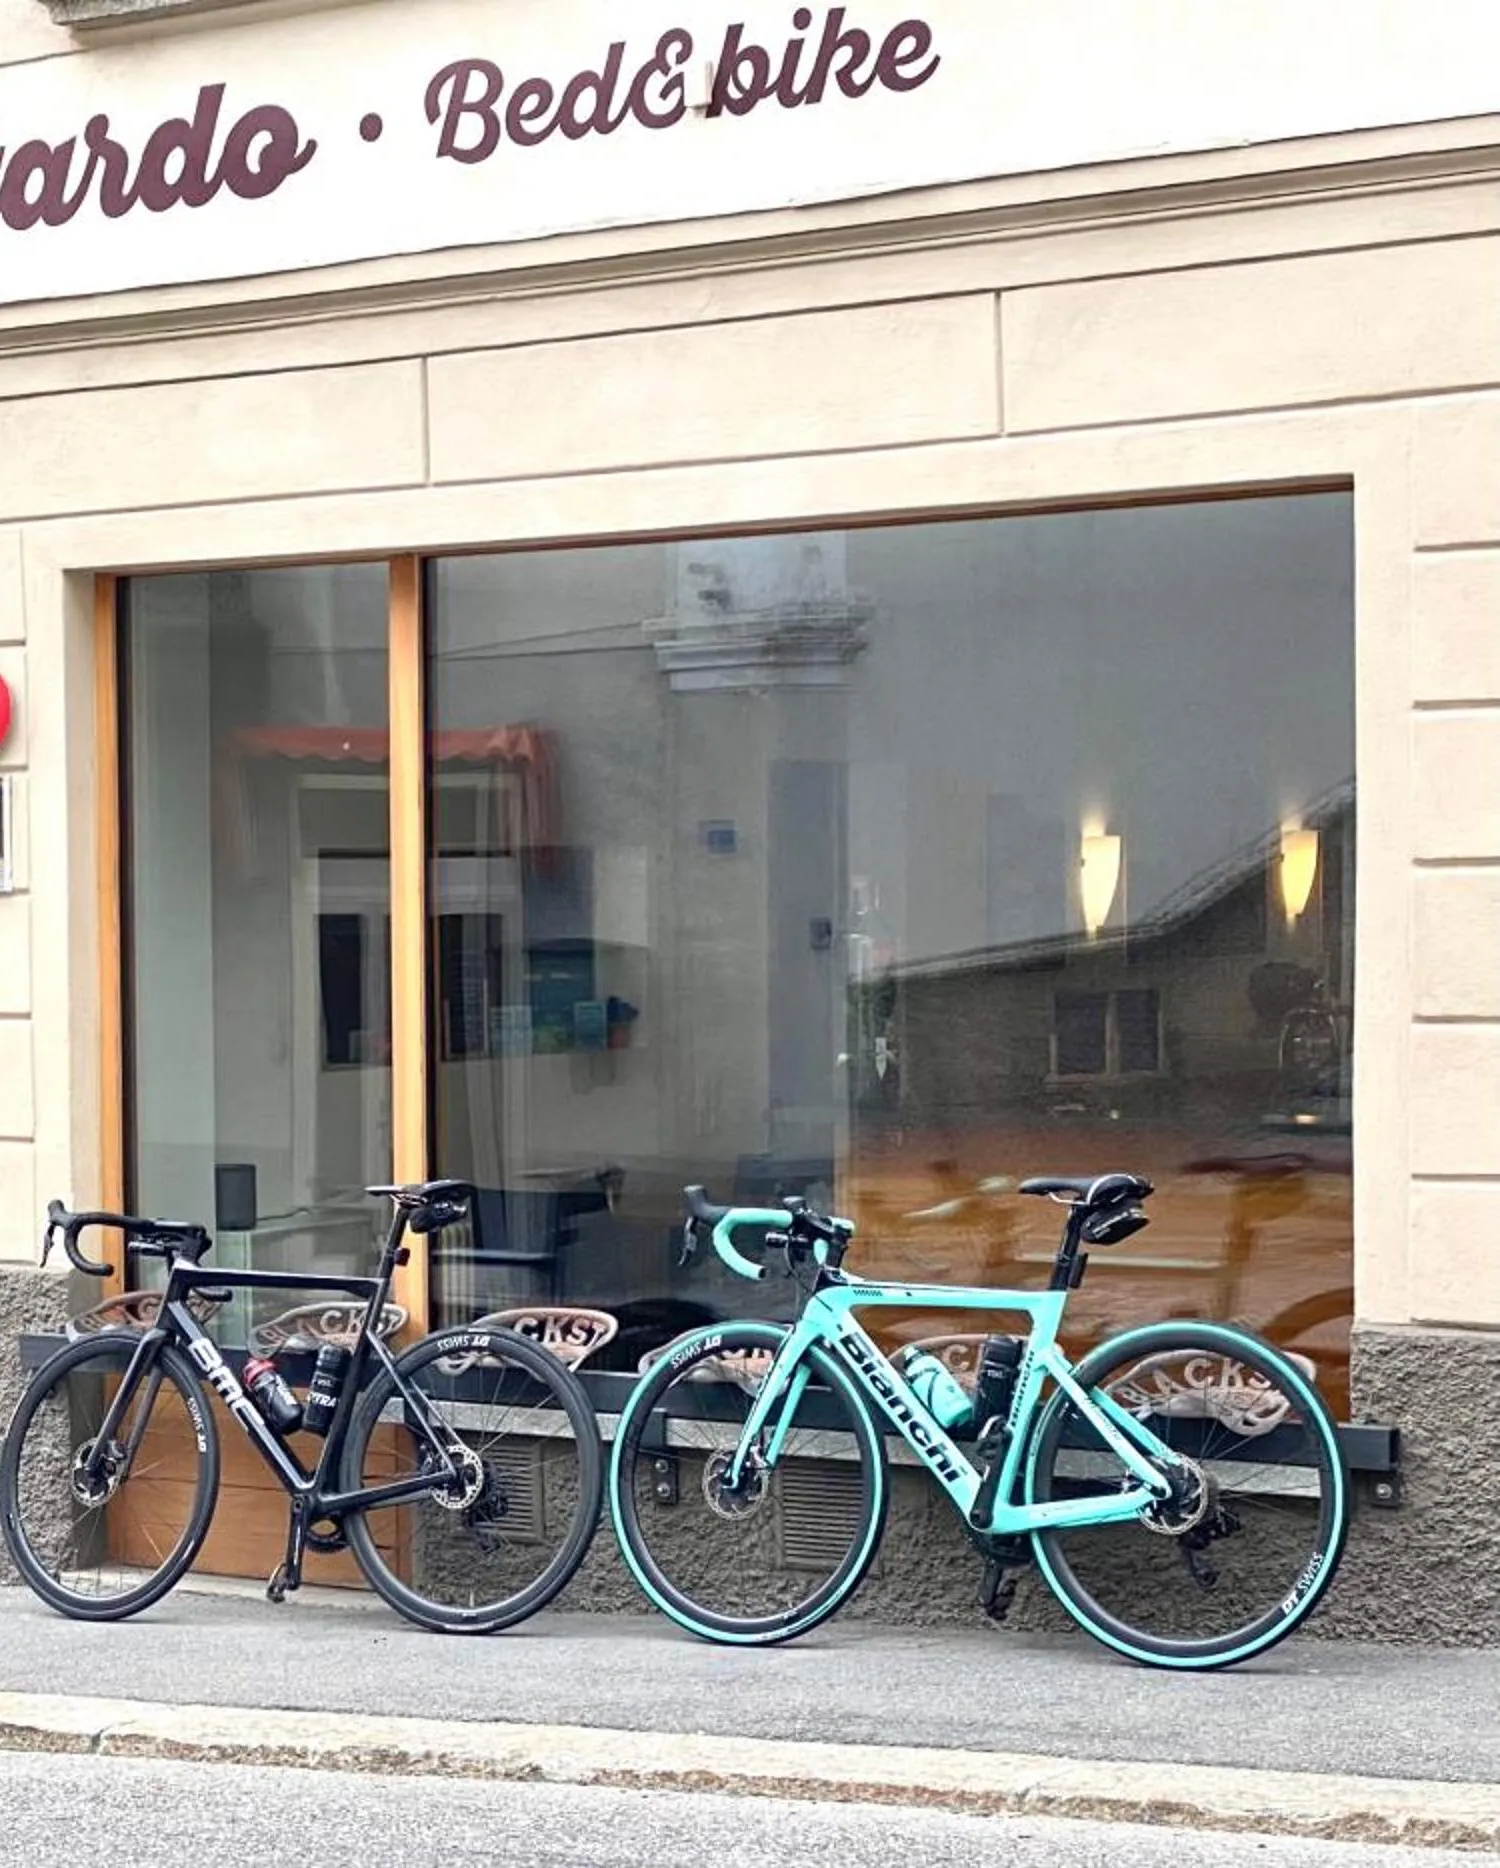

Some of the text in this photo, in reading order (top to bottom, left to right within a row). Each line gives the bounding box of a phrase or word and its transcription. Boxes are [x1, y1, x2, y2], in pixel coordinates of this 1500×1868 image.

[670, 1342, 701, 1369] SWISS
[1282, 1551, 1323, 1616] DT SWISS
